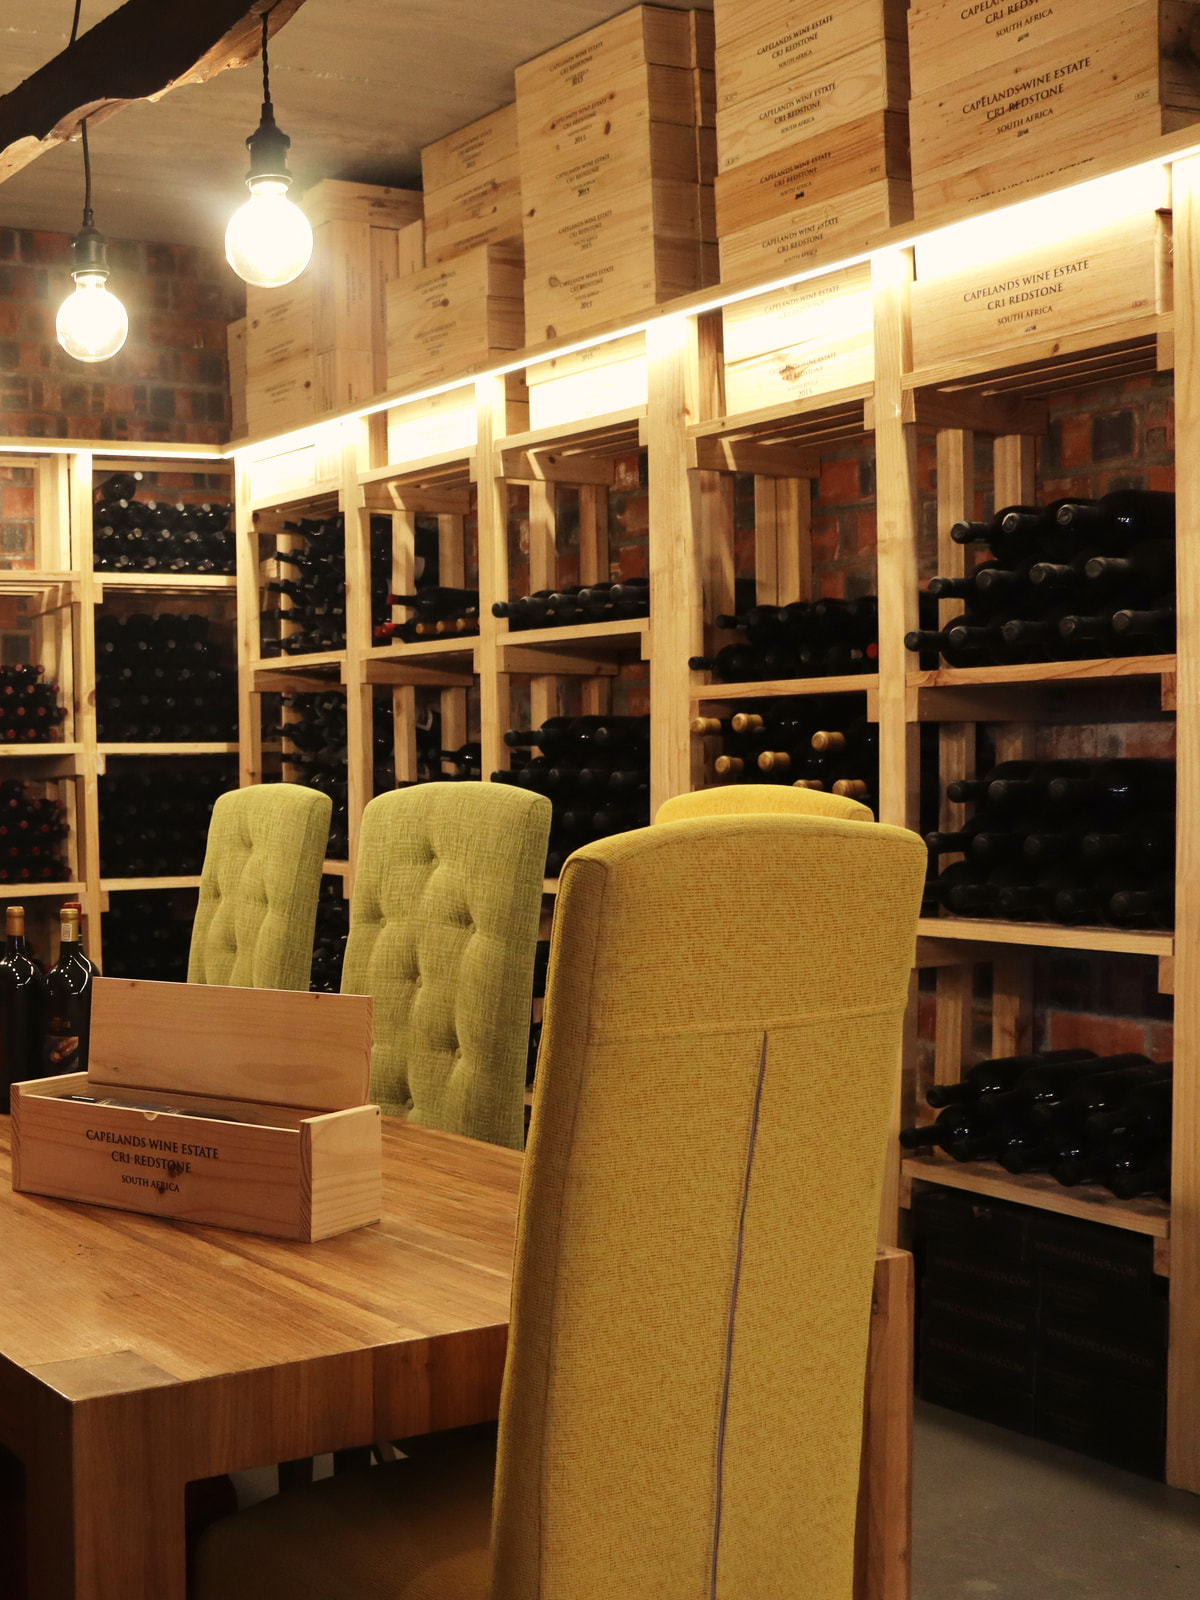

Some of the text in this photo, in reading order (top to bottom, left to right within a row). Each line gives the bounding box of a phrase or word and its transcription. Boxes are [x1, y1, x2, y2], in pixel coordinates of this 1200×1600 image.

[985, 10, 1003, 23] CR1
[996, 21, 1022, 38] SOUTH
[1024, 8, 1053, 25] AFRICA
[757, 15, 833, 55] CAPELANDS WINE ESTATE
[772, 33, 818, 59] CR1 REDSTONE
[963, 57, 1091, 114] CAPELANDS WINE ESTATE
[759, 83, 835, 120] CAPELANDS WINE ESTATE
[774, 101, 820, 125] CR1 REDSTONE
[987, 83, 1064, 120] CR1 REDSTONE
[997, 116, 1023, 134] SOUTH
[1026, 108, 1053, 123] AFRICA
[760, 165, 793, 183] CAPELANDS
[762, 231, 797, 248] CAPELANDS
[799, 225, 815, 237] WINE
[790, 233, 823, 250] REDSTONE
[964, 259, 1089, 303] CAPELANDS WINE ESTATE
[987, 283, 1064, 311] CR1 REDSTONE
[997, 305, 1053, 326] SOUTH AFRICA
[86, 1130, 218, 1159] CAPELANDS WINE ESTATE
[112, 1151, 191, 1173] CR1 REDSTONE
[122, 1174, 180, 1192] SOUTH AFRICA
